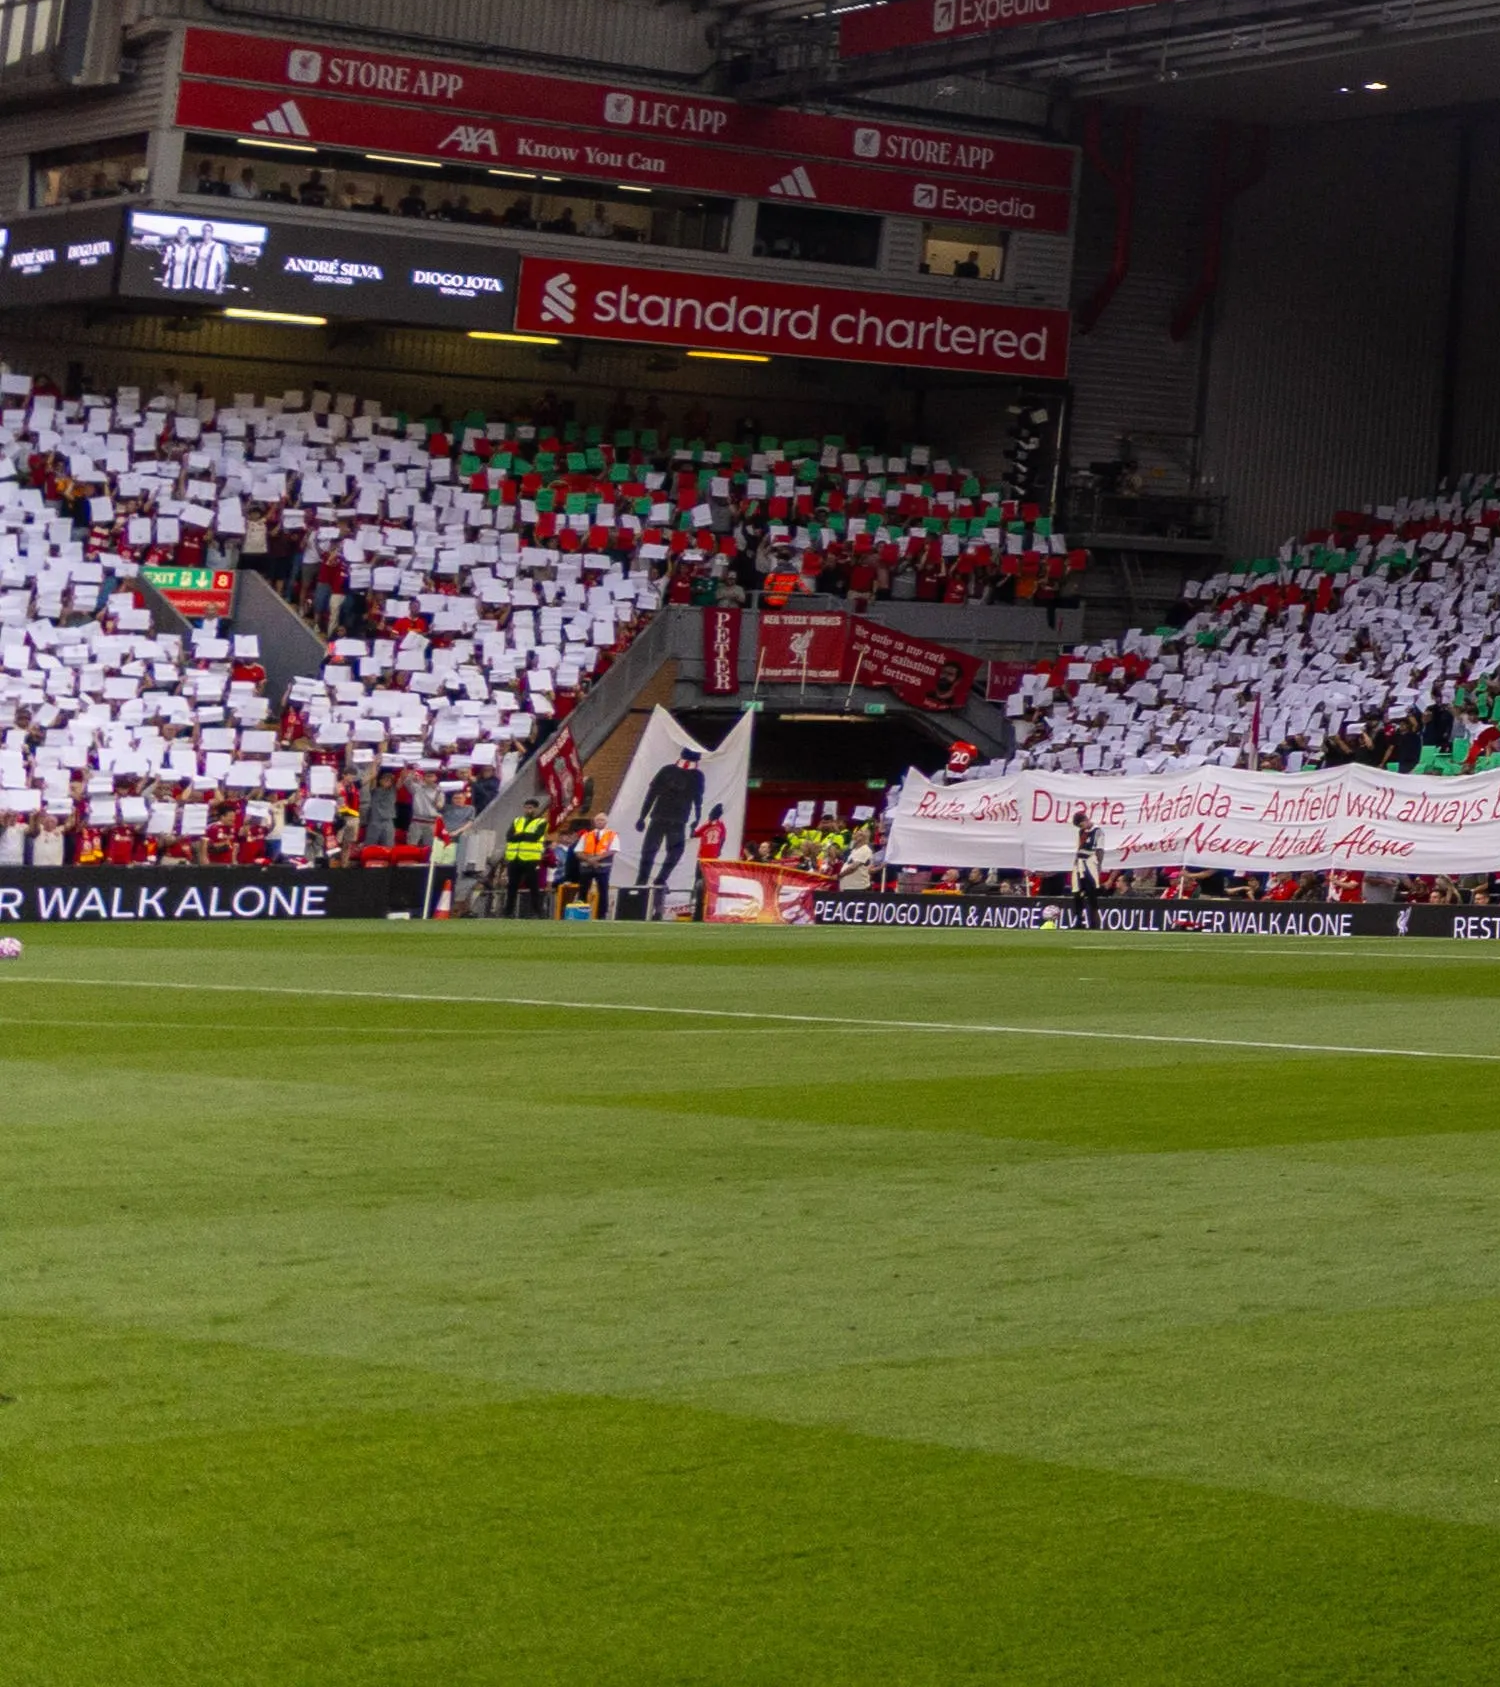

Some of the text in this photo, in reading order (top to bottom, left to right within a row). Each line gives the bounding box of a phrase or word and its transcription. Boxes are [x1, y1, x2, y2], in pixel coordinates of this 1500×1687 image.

[329, 58, 463, 100] STORE APP
[639, 103, 727, 134] LFC APP
[437, 125, 498, 156] AXA
[517, 138, 666, 173] Know You Can
[885, 135, 994, 171] STORE APP
[942, 189, 1036, 219] Expedia
[284, 258, 383, 280] ANDRÉ SILVA
[413, 270, 504, 292] DIOGO JOTA
[593, 285, 1047, 361] standard chartered
[217, 574, 229, 587] 8
[714, 612, 731, 690] PETER
[951, 751, 970, 765] 20
[912, 791, 966, 825] Rute,
[1032, 788, 1128, 830] Duarte,
[1138, 783, 1232, 825] Mafalda
[1261, 782, 1342, 823] Anfield
[1347, 786, 1394, 819] will
[1398, 791, 1486, 832] always
[1183, 821, 1264, 857] Never
[1266, 825, 1328, 858] Walk
[1331, 823, 1415, 858] Alone
[37, 887, 168, 919] WALK
[174, 886, 329, 917] ALONE
[814, 900, 1352, 936] PEACE DIOGO JOTA & ANDRÉ ILVA YOU'LL NEVER WALK ALONE
